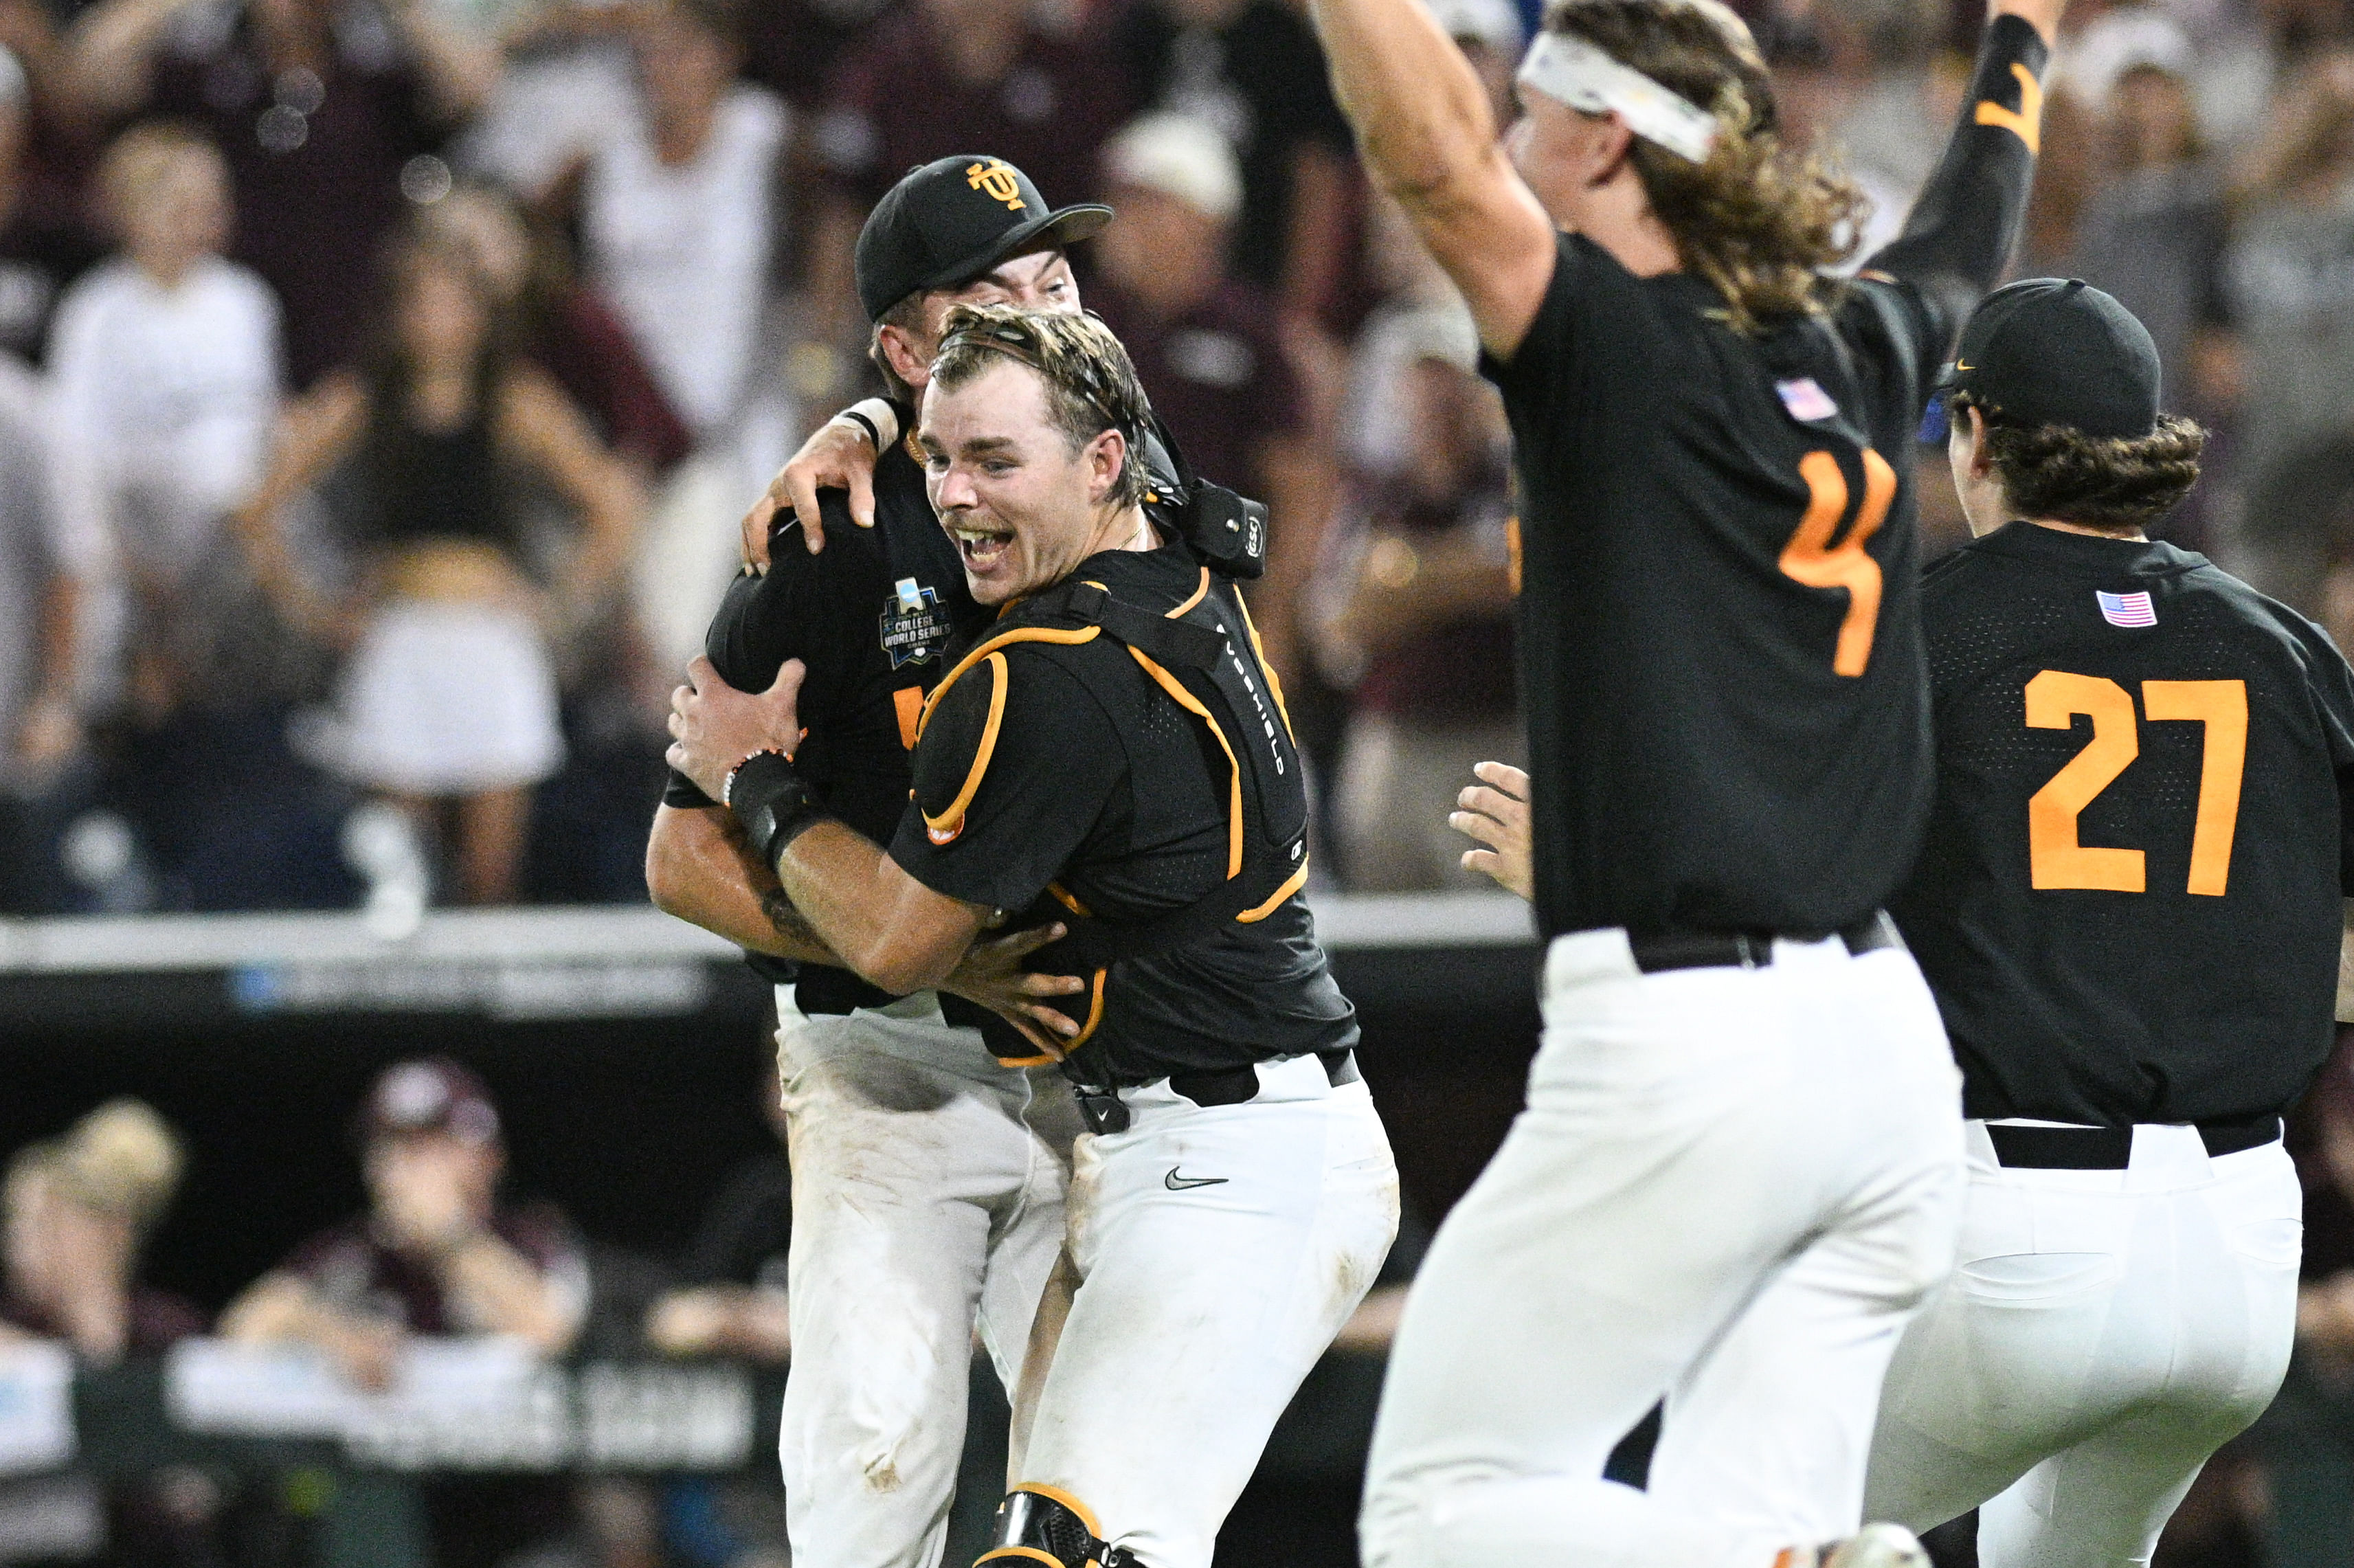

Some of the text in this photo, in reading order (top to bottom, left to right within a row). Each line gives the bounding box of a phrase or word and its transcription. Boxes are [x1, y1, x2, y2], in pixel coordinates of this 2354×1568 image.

[895, 615, 934, 633] COLLEGE
[1778, 447, 1897, 677] 4
[884, 623, 952, 648] WORLD SERIES
[2024, 669, 2249, 897] 27
